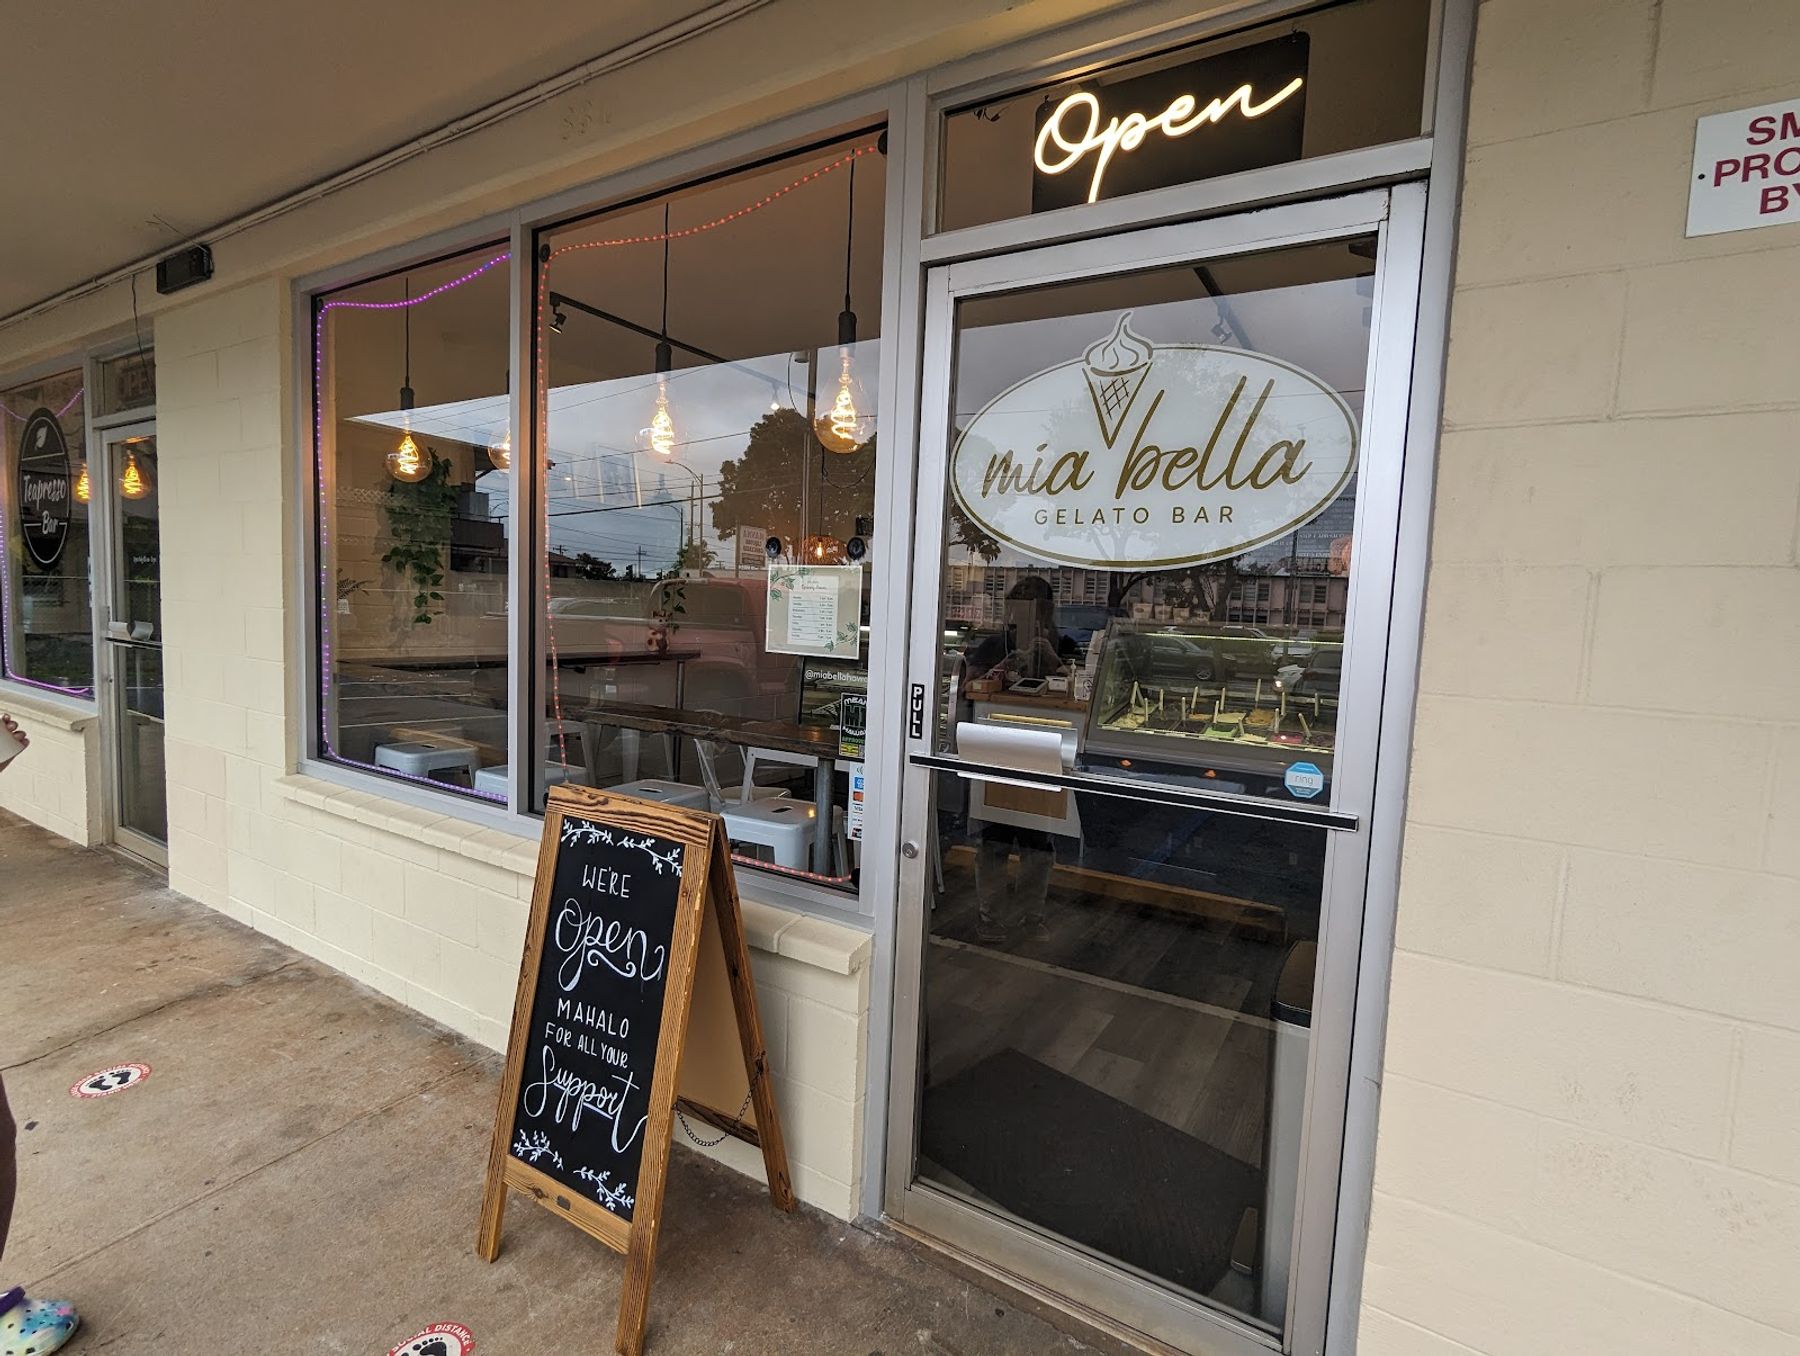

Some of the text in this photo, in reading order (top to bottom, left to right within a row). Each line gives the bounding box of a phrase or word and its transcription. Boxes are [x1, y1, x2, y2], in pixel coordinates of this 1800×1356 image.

[1034, 77, 1303, 204] Open
[1760, 183, 1800, 214] B
[981, 375, 1313, 499] mia bella
[23, 474, 67, 511] Teapresso
[41, 510, 59, 535] Bar
[1034, 505, 1234, 525] GELATO BAR
[912, 686, 923, 737] PULL
[1295, 775, 1314, 787] ring
[554, 897, 666, 991] Open
[556, 997, 631, 1039] MAHALO
[544, 1021, 628, 1068] FOR ALL YOUR
[523, 1045, 649, 1154] Support
[434, 1323, 471, 1346] DISTANCE
